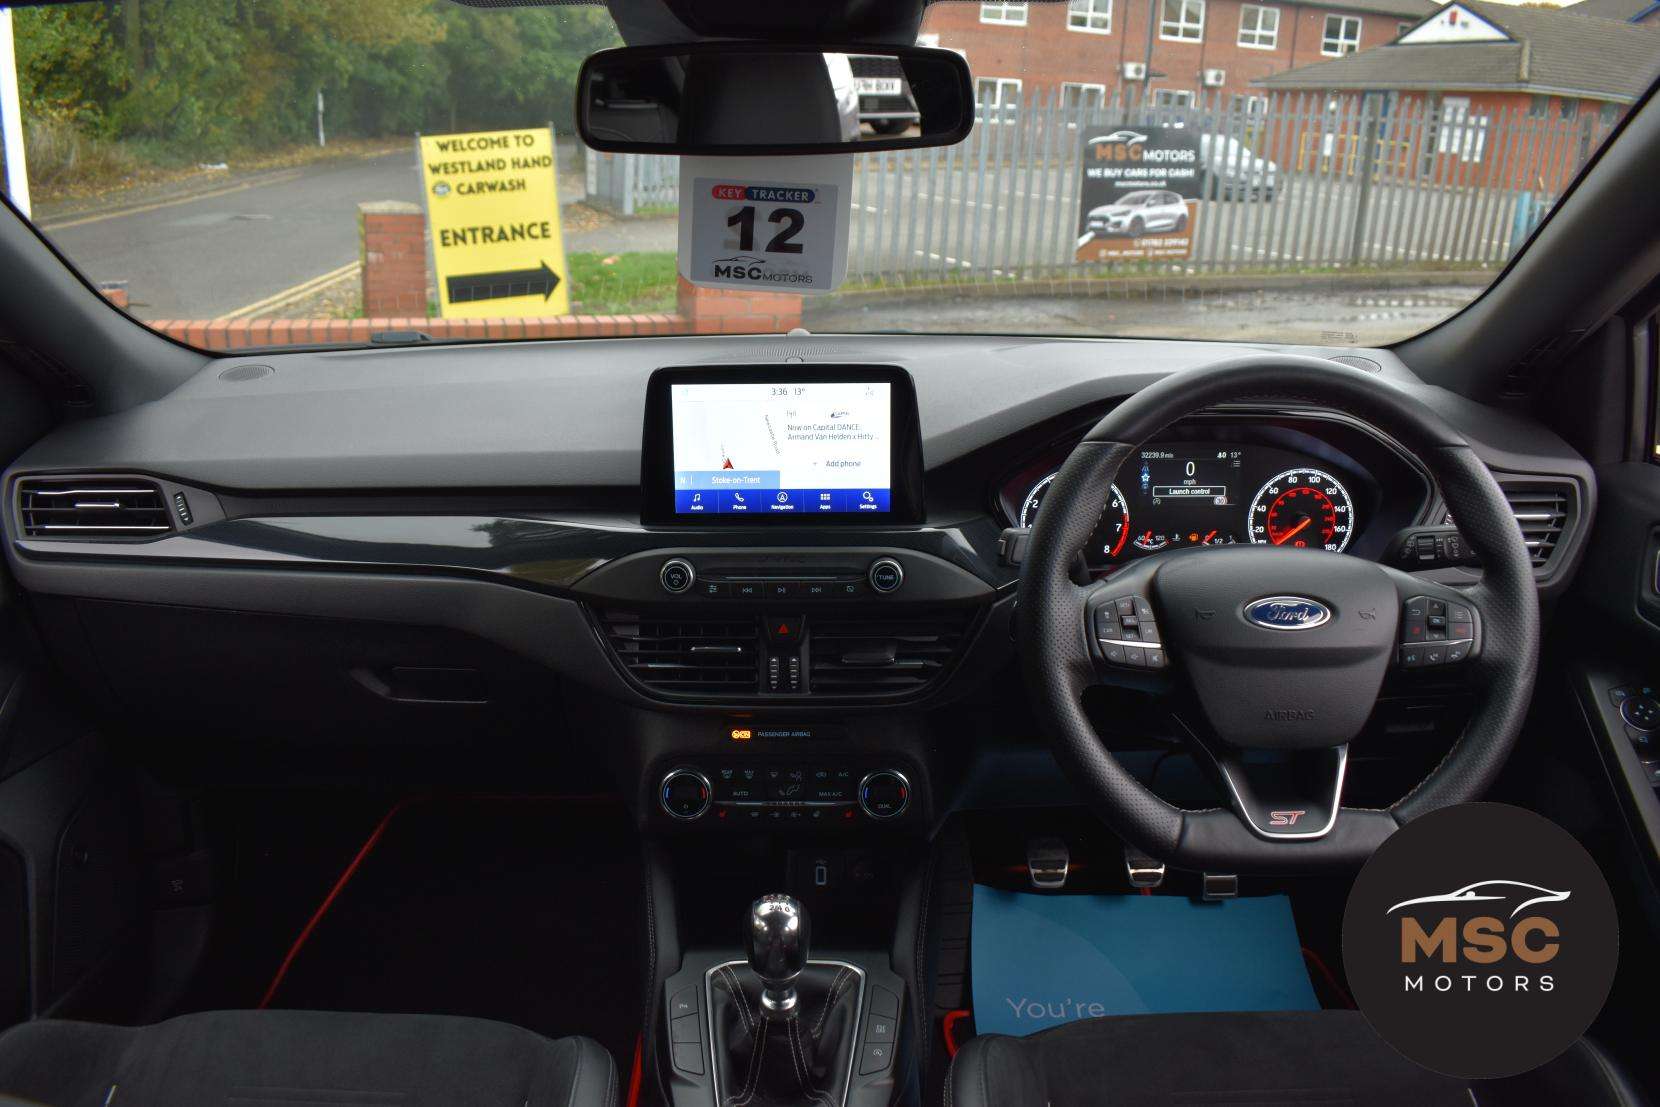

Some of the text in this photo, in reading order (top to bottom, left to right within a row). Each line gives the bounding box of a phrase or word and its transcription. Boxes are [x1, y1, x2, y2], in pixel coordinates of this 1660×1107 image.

[437, 134, 535, 152] WELCOME TO
[1095, 144, 1196, 163] MSC MOTORS
[428, 156, 553, 175] WESTLAND HAND
[1087, 168, 1102, 178] WE
[1103, 168, 1122, 178] BUY
[1124, 168, 1147, 178] CARS
[1149, 168, 1167, 178] FOR
[456, 179, 526, 195] CARWASH
[718, 187, 809, 201] KEY TRACKER
[440, 222, 551, 247] ENTRANCE
[727, 205, 805, 254] 12
[714, 264, 813, 284] MSC MOTORS
[771, 387, 788, 396] 3:36
[812, 424, 836, 432] Capital
[840, 460, 862, 469] phone
[1186, 461, 1195, 476] 0
[711, 476, 761, 485] Stoke-on-Trent
[1184, 478, 1197, 486] mph
[1032, 500, 1039, 508] 2
[1112, 500, 1118, 508] 6
[1116, 523, 1122, 532] 7
[1103, 545, 1110, 554] 8
[1268, 603, 1309, 621] Ford
[1264, 710, 1314, 721] AIRBAG
[1269, 810, 1305, 825] ST
[1007, 998, 1105, 1018] You're
